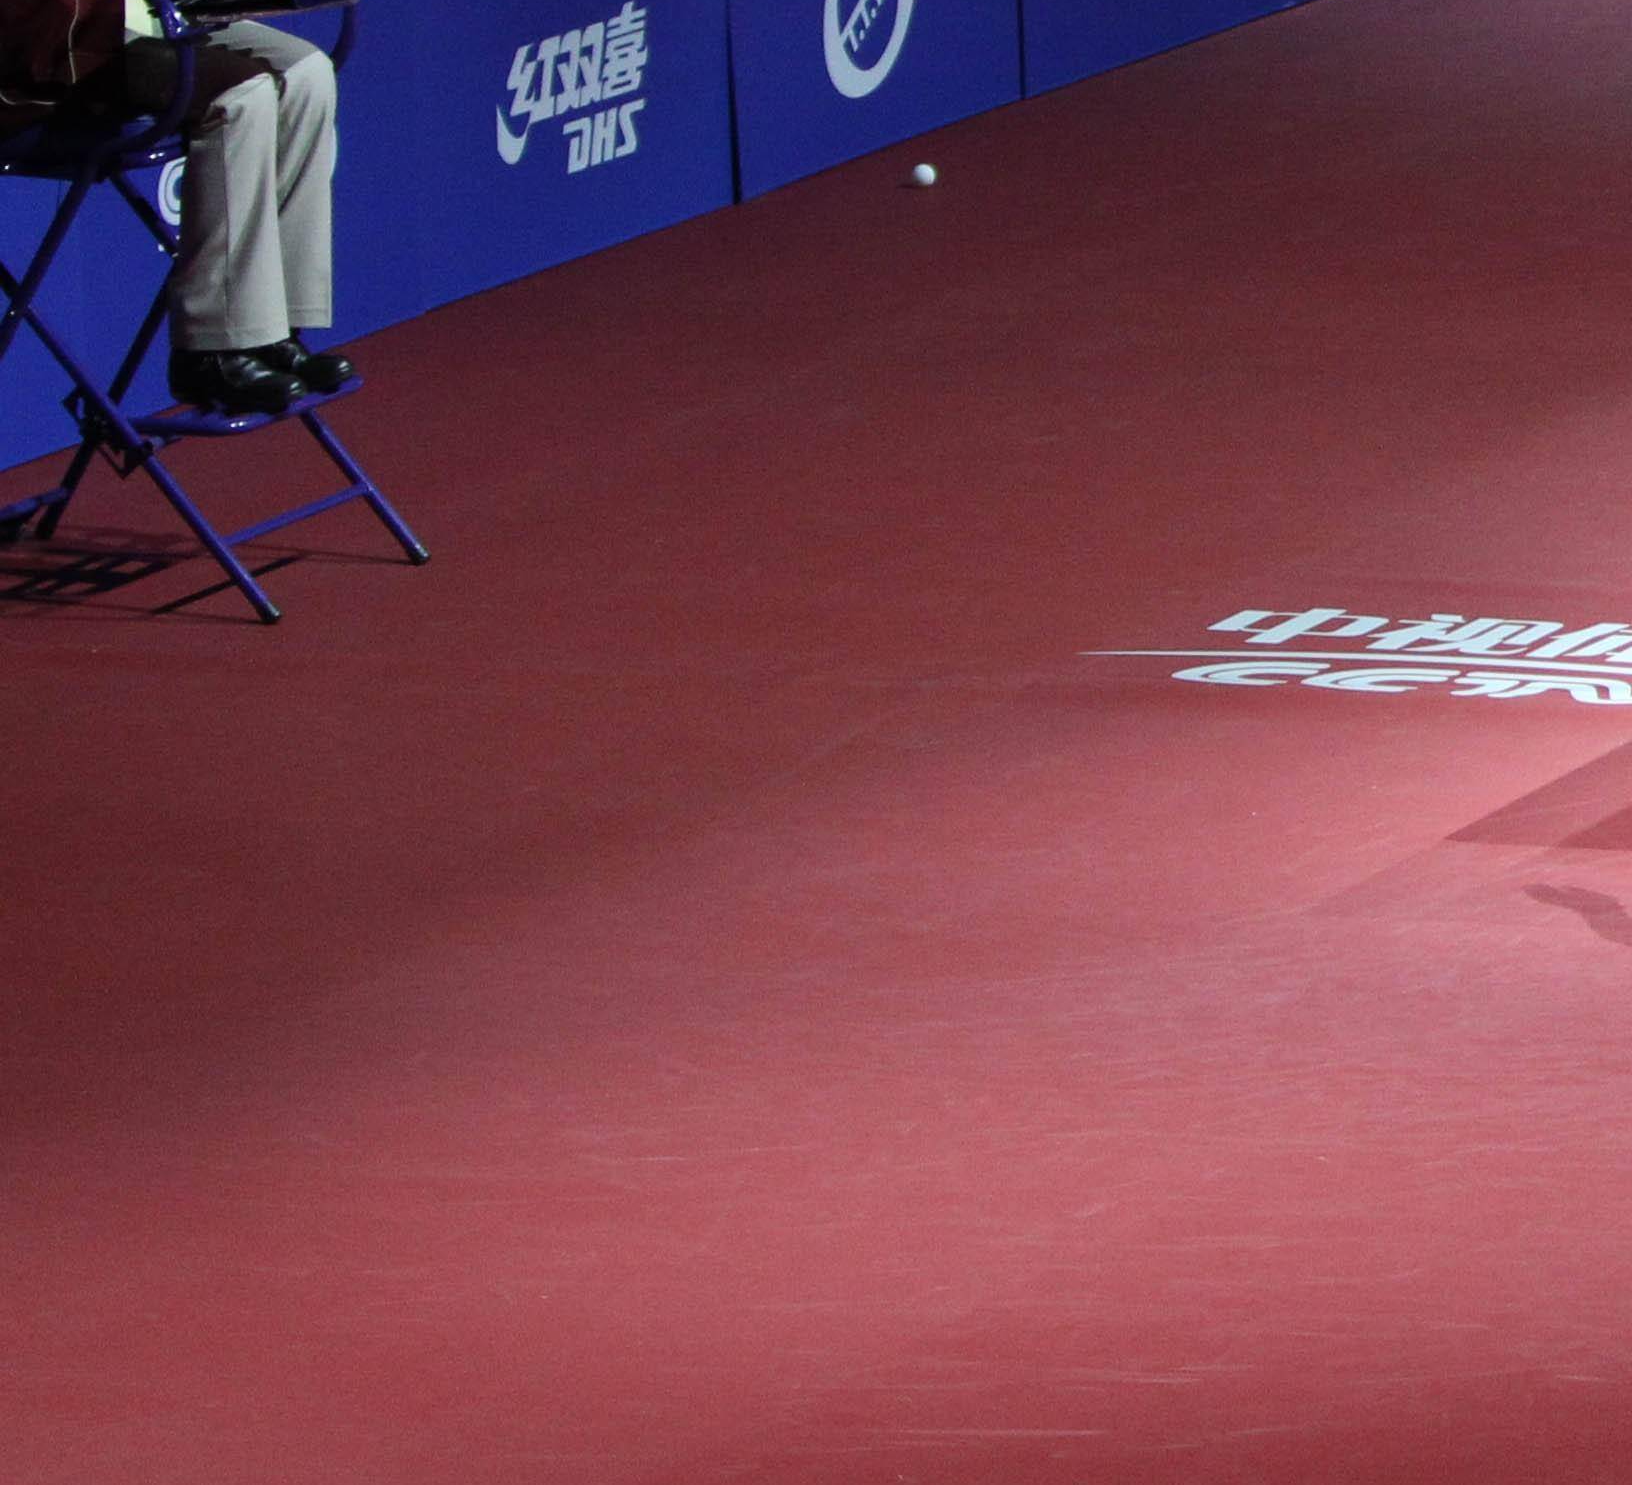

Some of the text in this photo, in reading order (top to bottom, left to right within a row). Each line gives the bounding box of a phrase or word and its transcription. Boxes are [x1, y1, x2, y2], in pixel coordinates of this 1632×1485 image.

[496, 0, 648, 165] 红双喜
[562, 98, 646, 175] DHS
